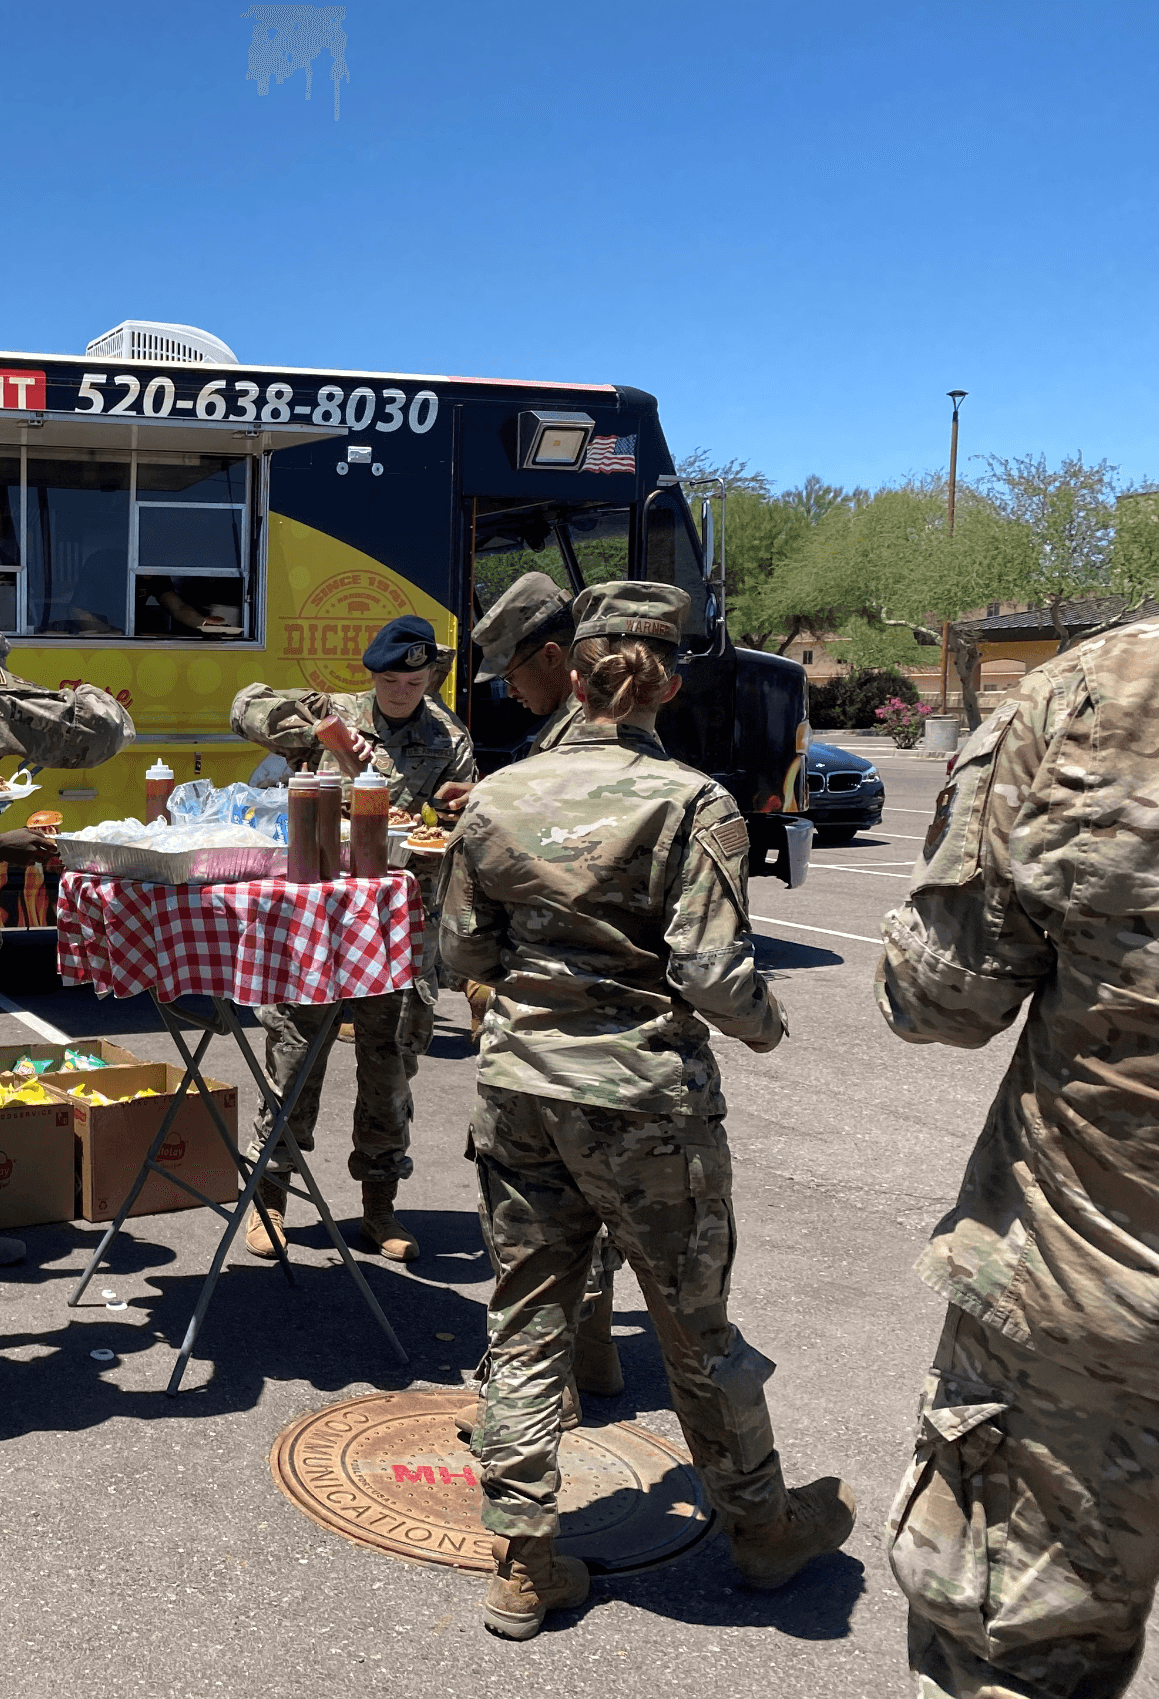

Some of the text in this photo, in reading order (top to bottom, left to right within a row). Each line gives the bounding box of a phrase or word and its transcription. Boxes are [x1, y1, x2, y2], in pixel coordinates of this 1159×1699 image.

[74, 373, 439, 435] 520-638-8030
[311, 574, 407, 609] SINCE 1941
[301, 1411, 493, 1557] COMMUNICATIONS
[392, 1464, 478, 1487] MH
